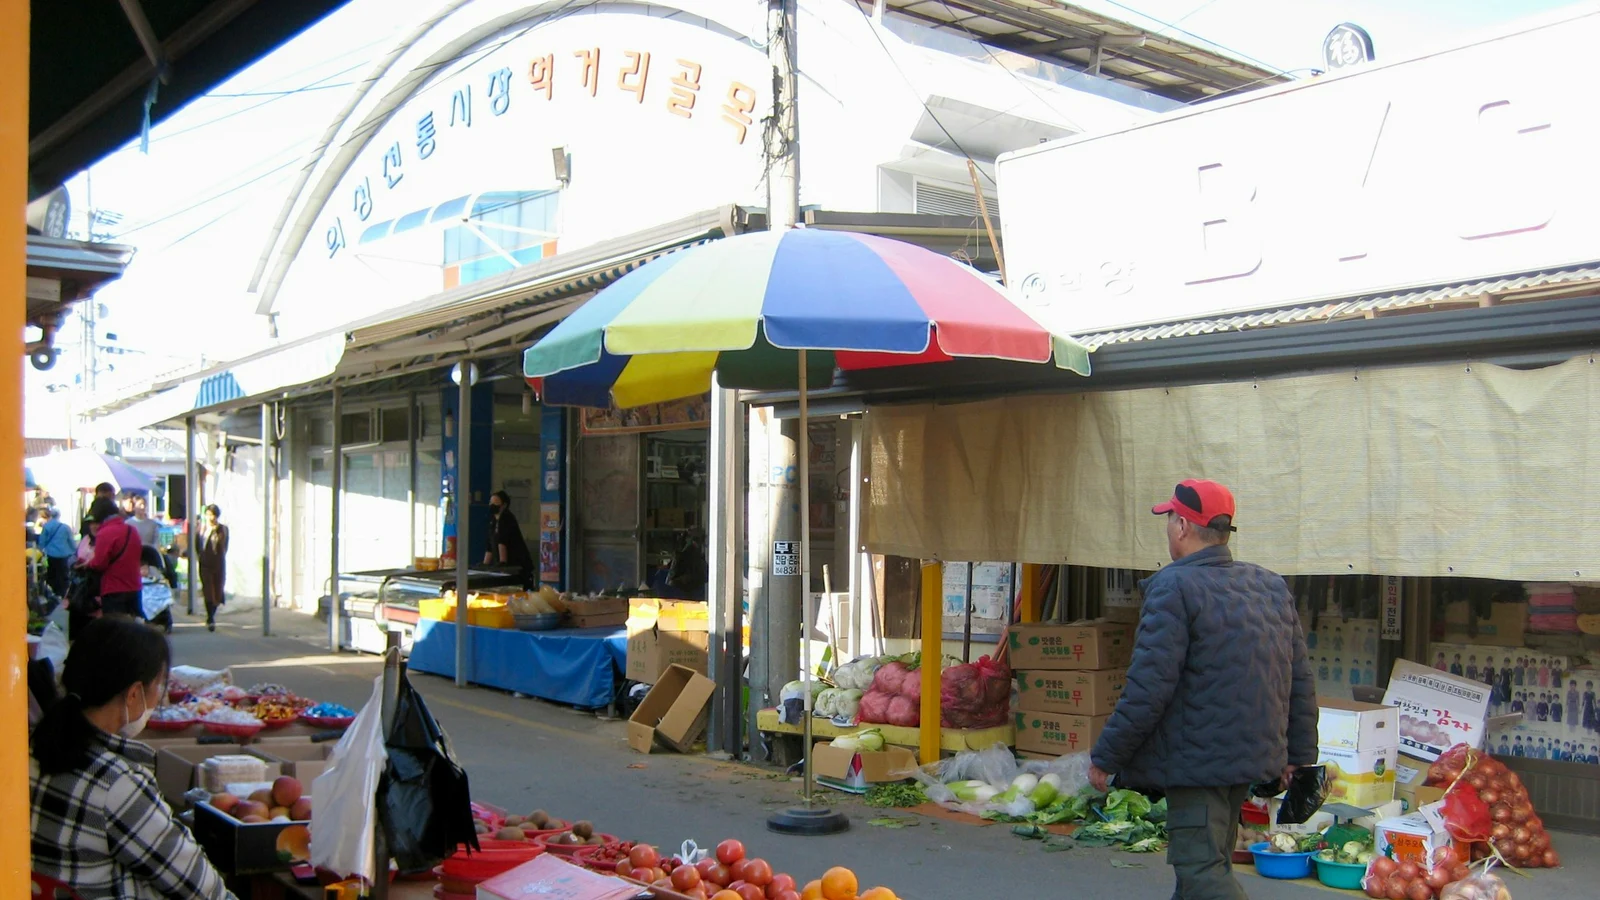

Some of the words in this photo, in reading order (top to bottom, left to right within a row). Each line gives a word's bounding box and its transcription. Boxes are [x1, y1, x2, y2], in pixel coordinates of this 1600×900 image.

[327, 67, 513, 259] 의성전통시장
[528, 47, 757, 145] 먹거리골목
[1072, 644, 1084, 662] 무
[1072, 690, 1082, 708] 무
[1432, 709, 1473, 732] 감자
[1068, 732, 1079, 750] 무
